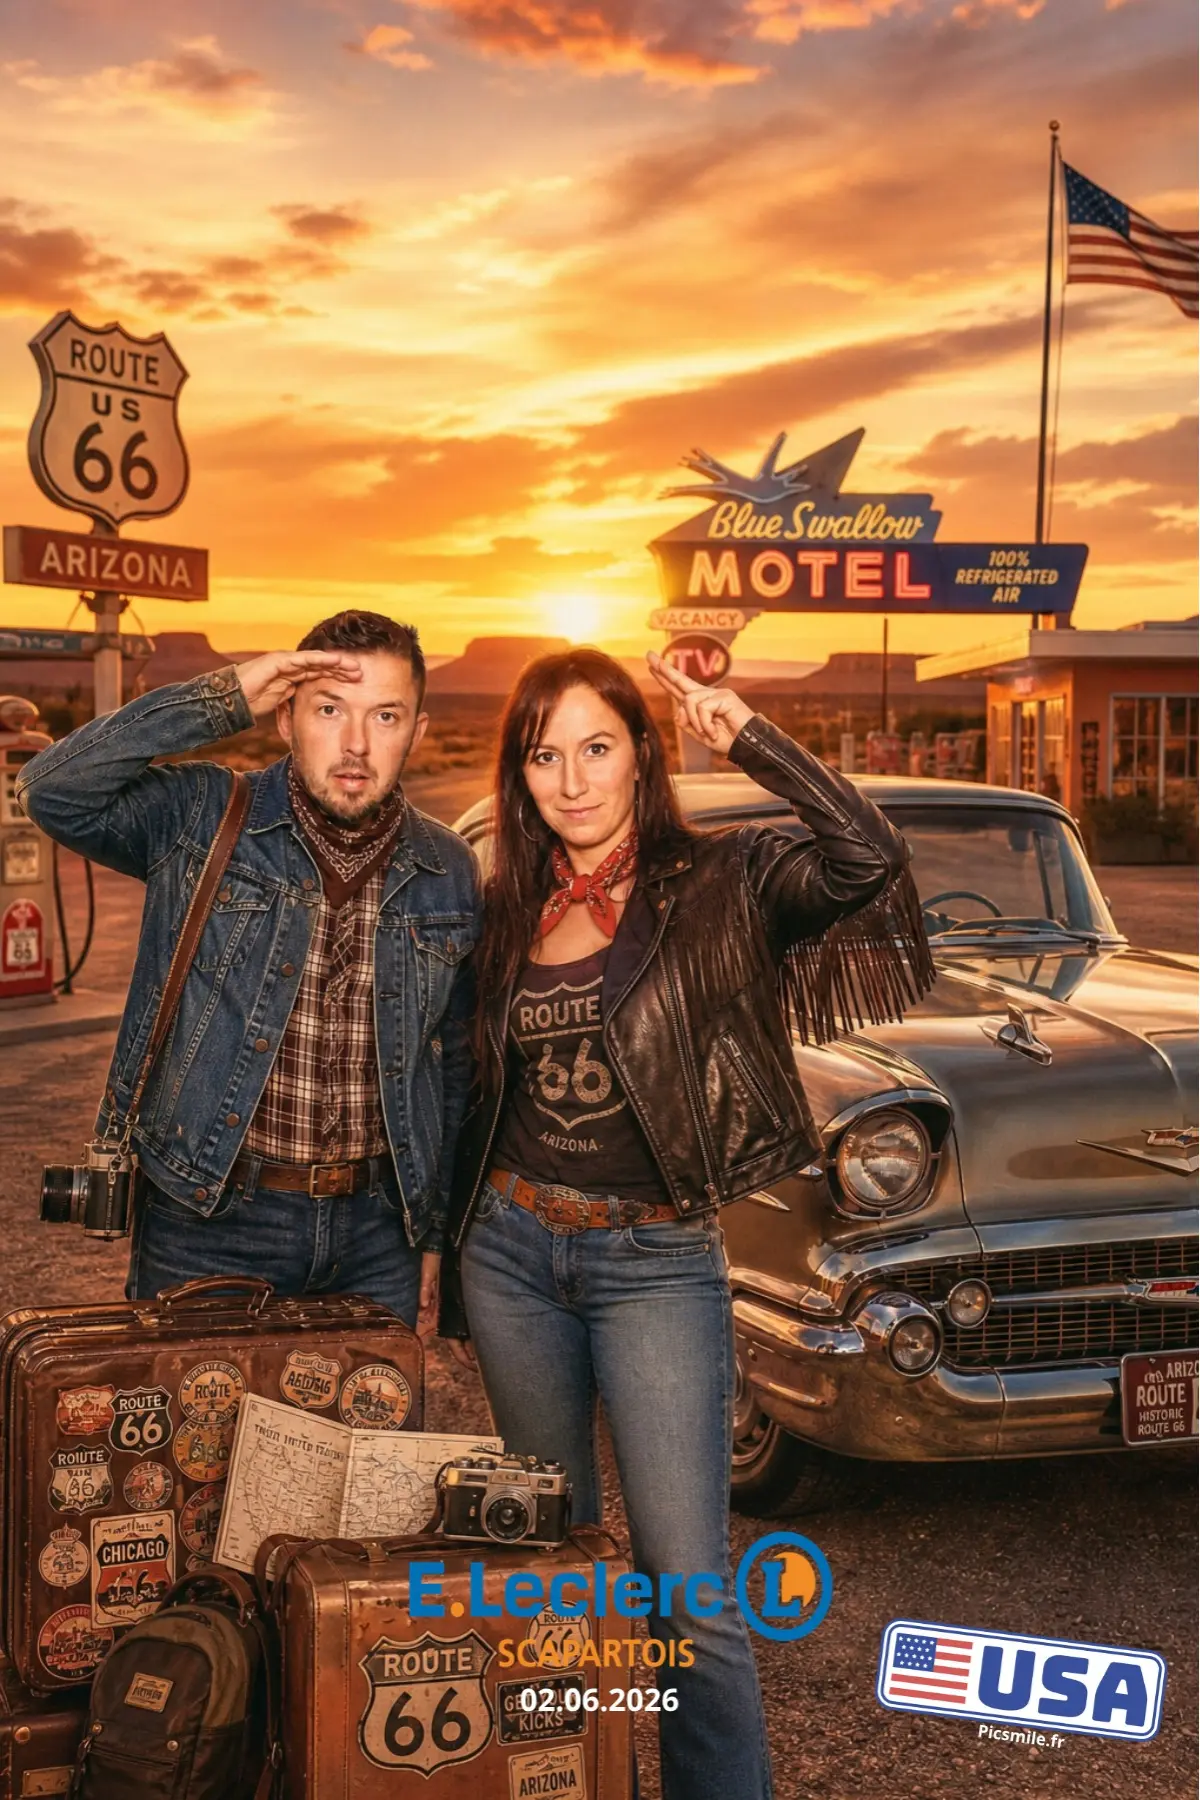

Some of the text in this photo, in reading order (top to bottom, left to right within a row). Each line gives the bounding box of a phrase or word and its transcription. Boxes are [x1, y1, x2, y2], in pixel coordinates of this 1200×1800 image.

[70, 338, 160, 386] ROUTE
[73, 422, 158, 501] 66
[707, 501, 923, 541] Blue Swallow
[40, 542, 192, 588] ARIZONA
[988, 551, 1030, 567] 100%
[687, 549, 932, 600] MOTEL
[955, 569, 1059, 586] REFRIGERATED
[992, 586, 1020, 604] AIR
[656, 612, 739, 627] VACANCY
[671, 648, 721, 677] TV
[520, 995, 600, 1032] ROUTE
[536, 1038, 612, 1104] 66
[119, 1395, 162, 1411] ROUTE
[1136, 1383, 1187, 1408] ROUTE
[120, 1412, 163, 1447] 66
[1138, 1422, 1170, 1436] ROUTE
[1139, 1407, 1184, 1423] HISTORIC
[103, 1540, 165, 1563] CHICAGO
[383, 1648, 473, 1677] ROUTE
[383, 1687, 471, 1756] 66
[519, 1710, 564, 1732] KICKS
[519, 1768, 577, 1797] ARIZONA
